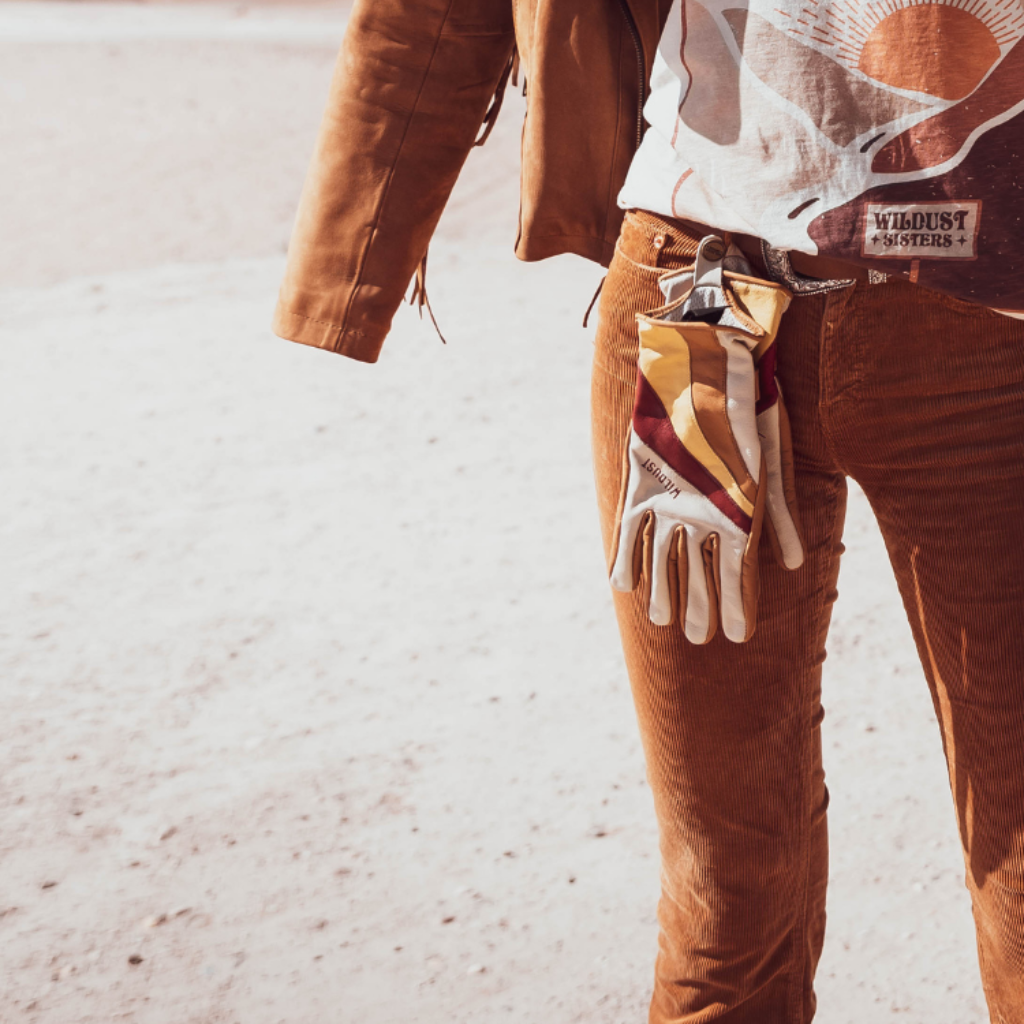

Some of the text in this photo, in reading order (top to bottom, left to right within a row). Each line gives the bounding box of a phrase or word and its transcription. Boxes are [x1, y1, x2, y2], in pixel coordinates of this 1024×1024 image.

[873, 210, 969, 231] WILDUST
[883, 233, 953, 248] SISTERS
[641, 458, 682, 499] WILDUST
